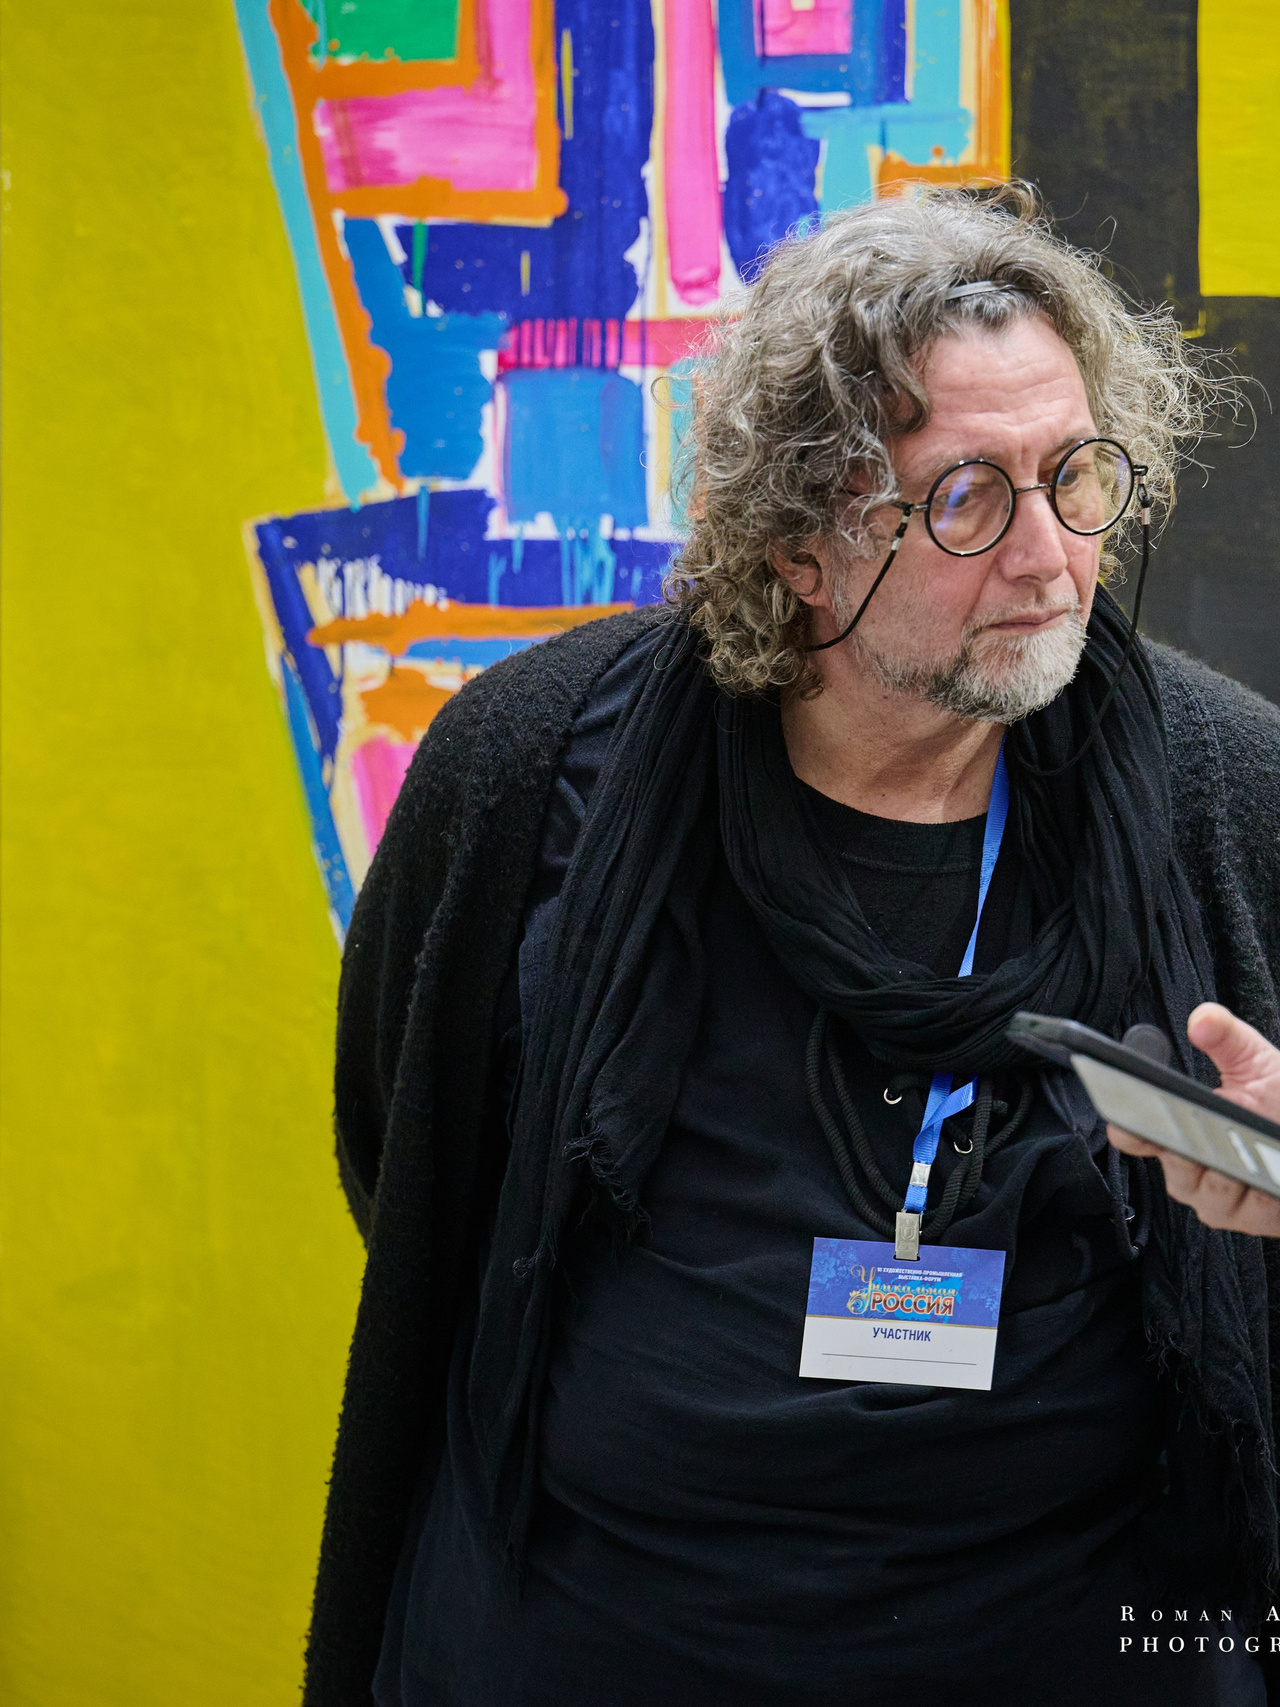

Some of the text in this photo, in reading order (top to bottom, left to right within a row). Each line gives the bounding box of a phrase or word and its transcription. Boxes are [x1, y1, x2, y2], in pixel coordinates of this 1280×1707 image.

[898, 1274, 942, 1282] ВЫСТАВКА-ФОРУМ
[870, 1292, 955, 1316] РОССИЯ
[873, 1327, 931, 1341] УЧАСТНИК
